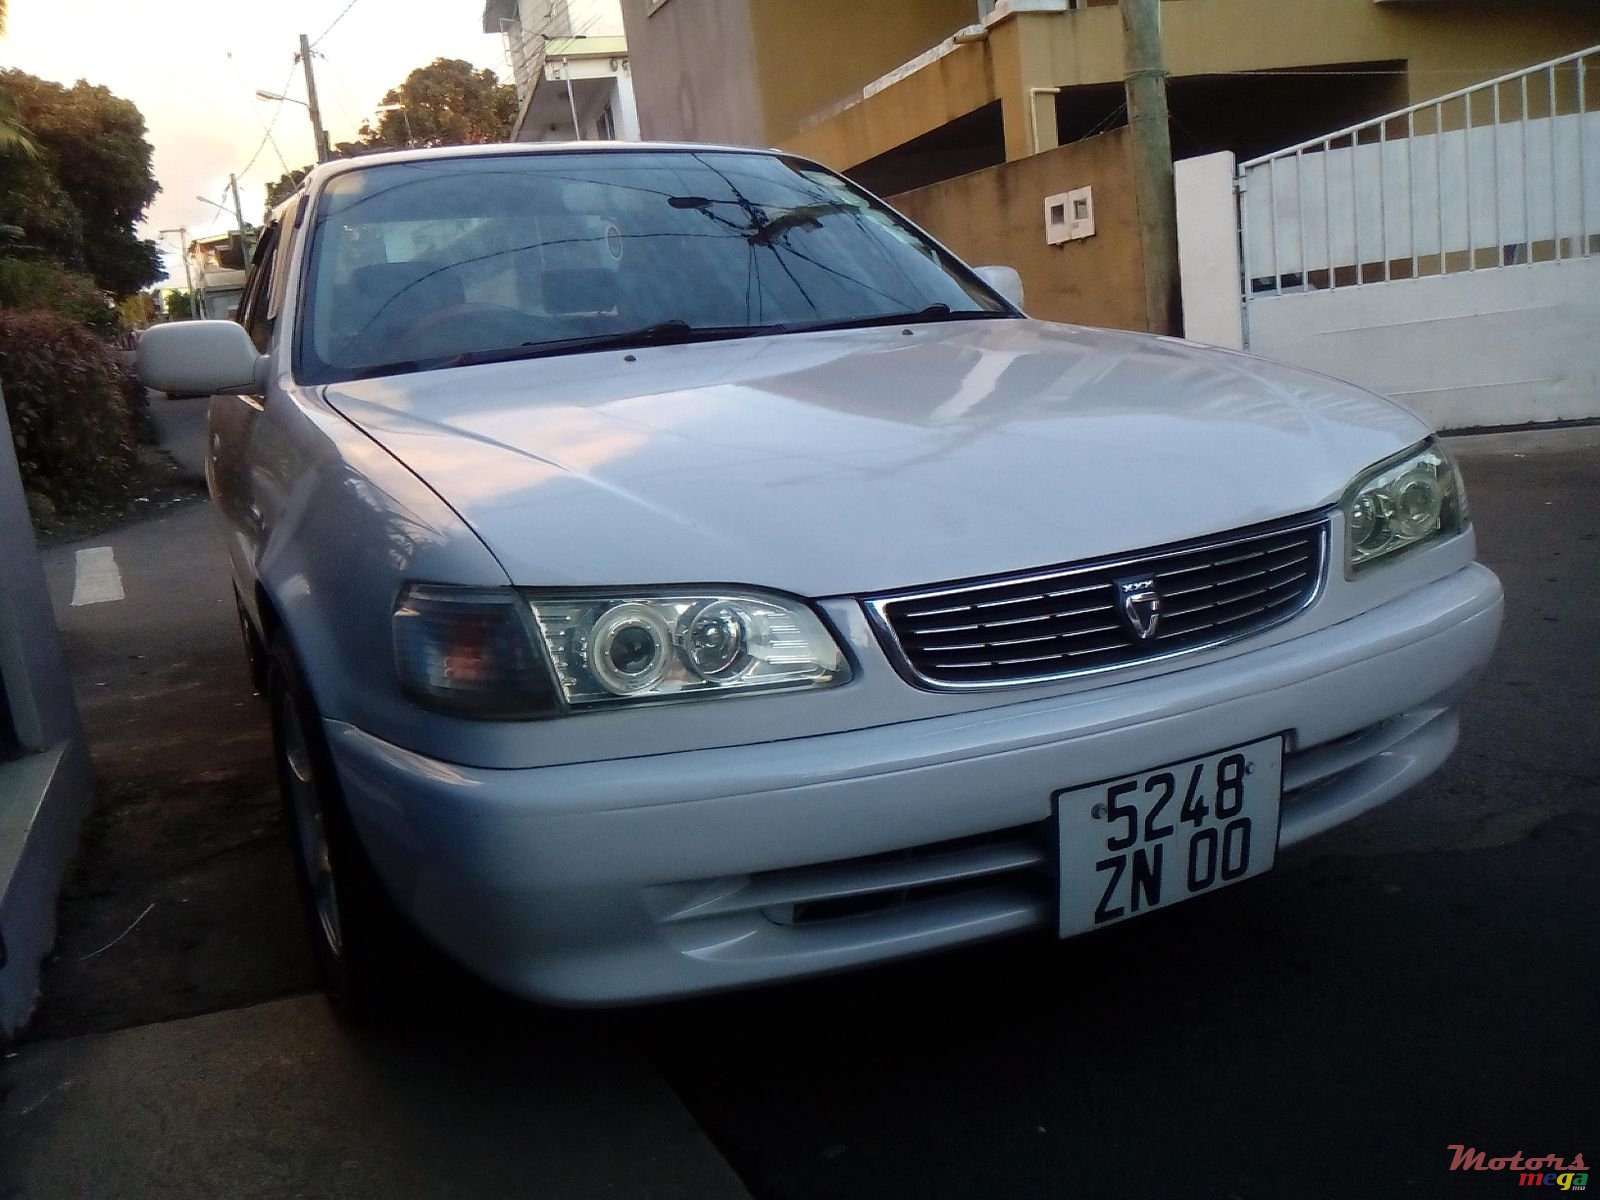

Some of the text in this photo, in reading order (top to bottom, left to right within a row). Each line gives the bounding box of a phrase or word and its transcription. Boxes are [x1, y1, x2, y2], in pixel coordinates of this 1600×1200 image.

[1107, 754, 1246, 851] 5248
[1094, 817, 1252, 924] ZN 00
